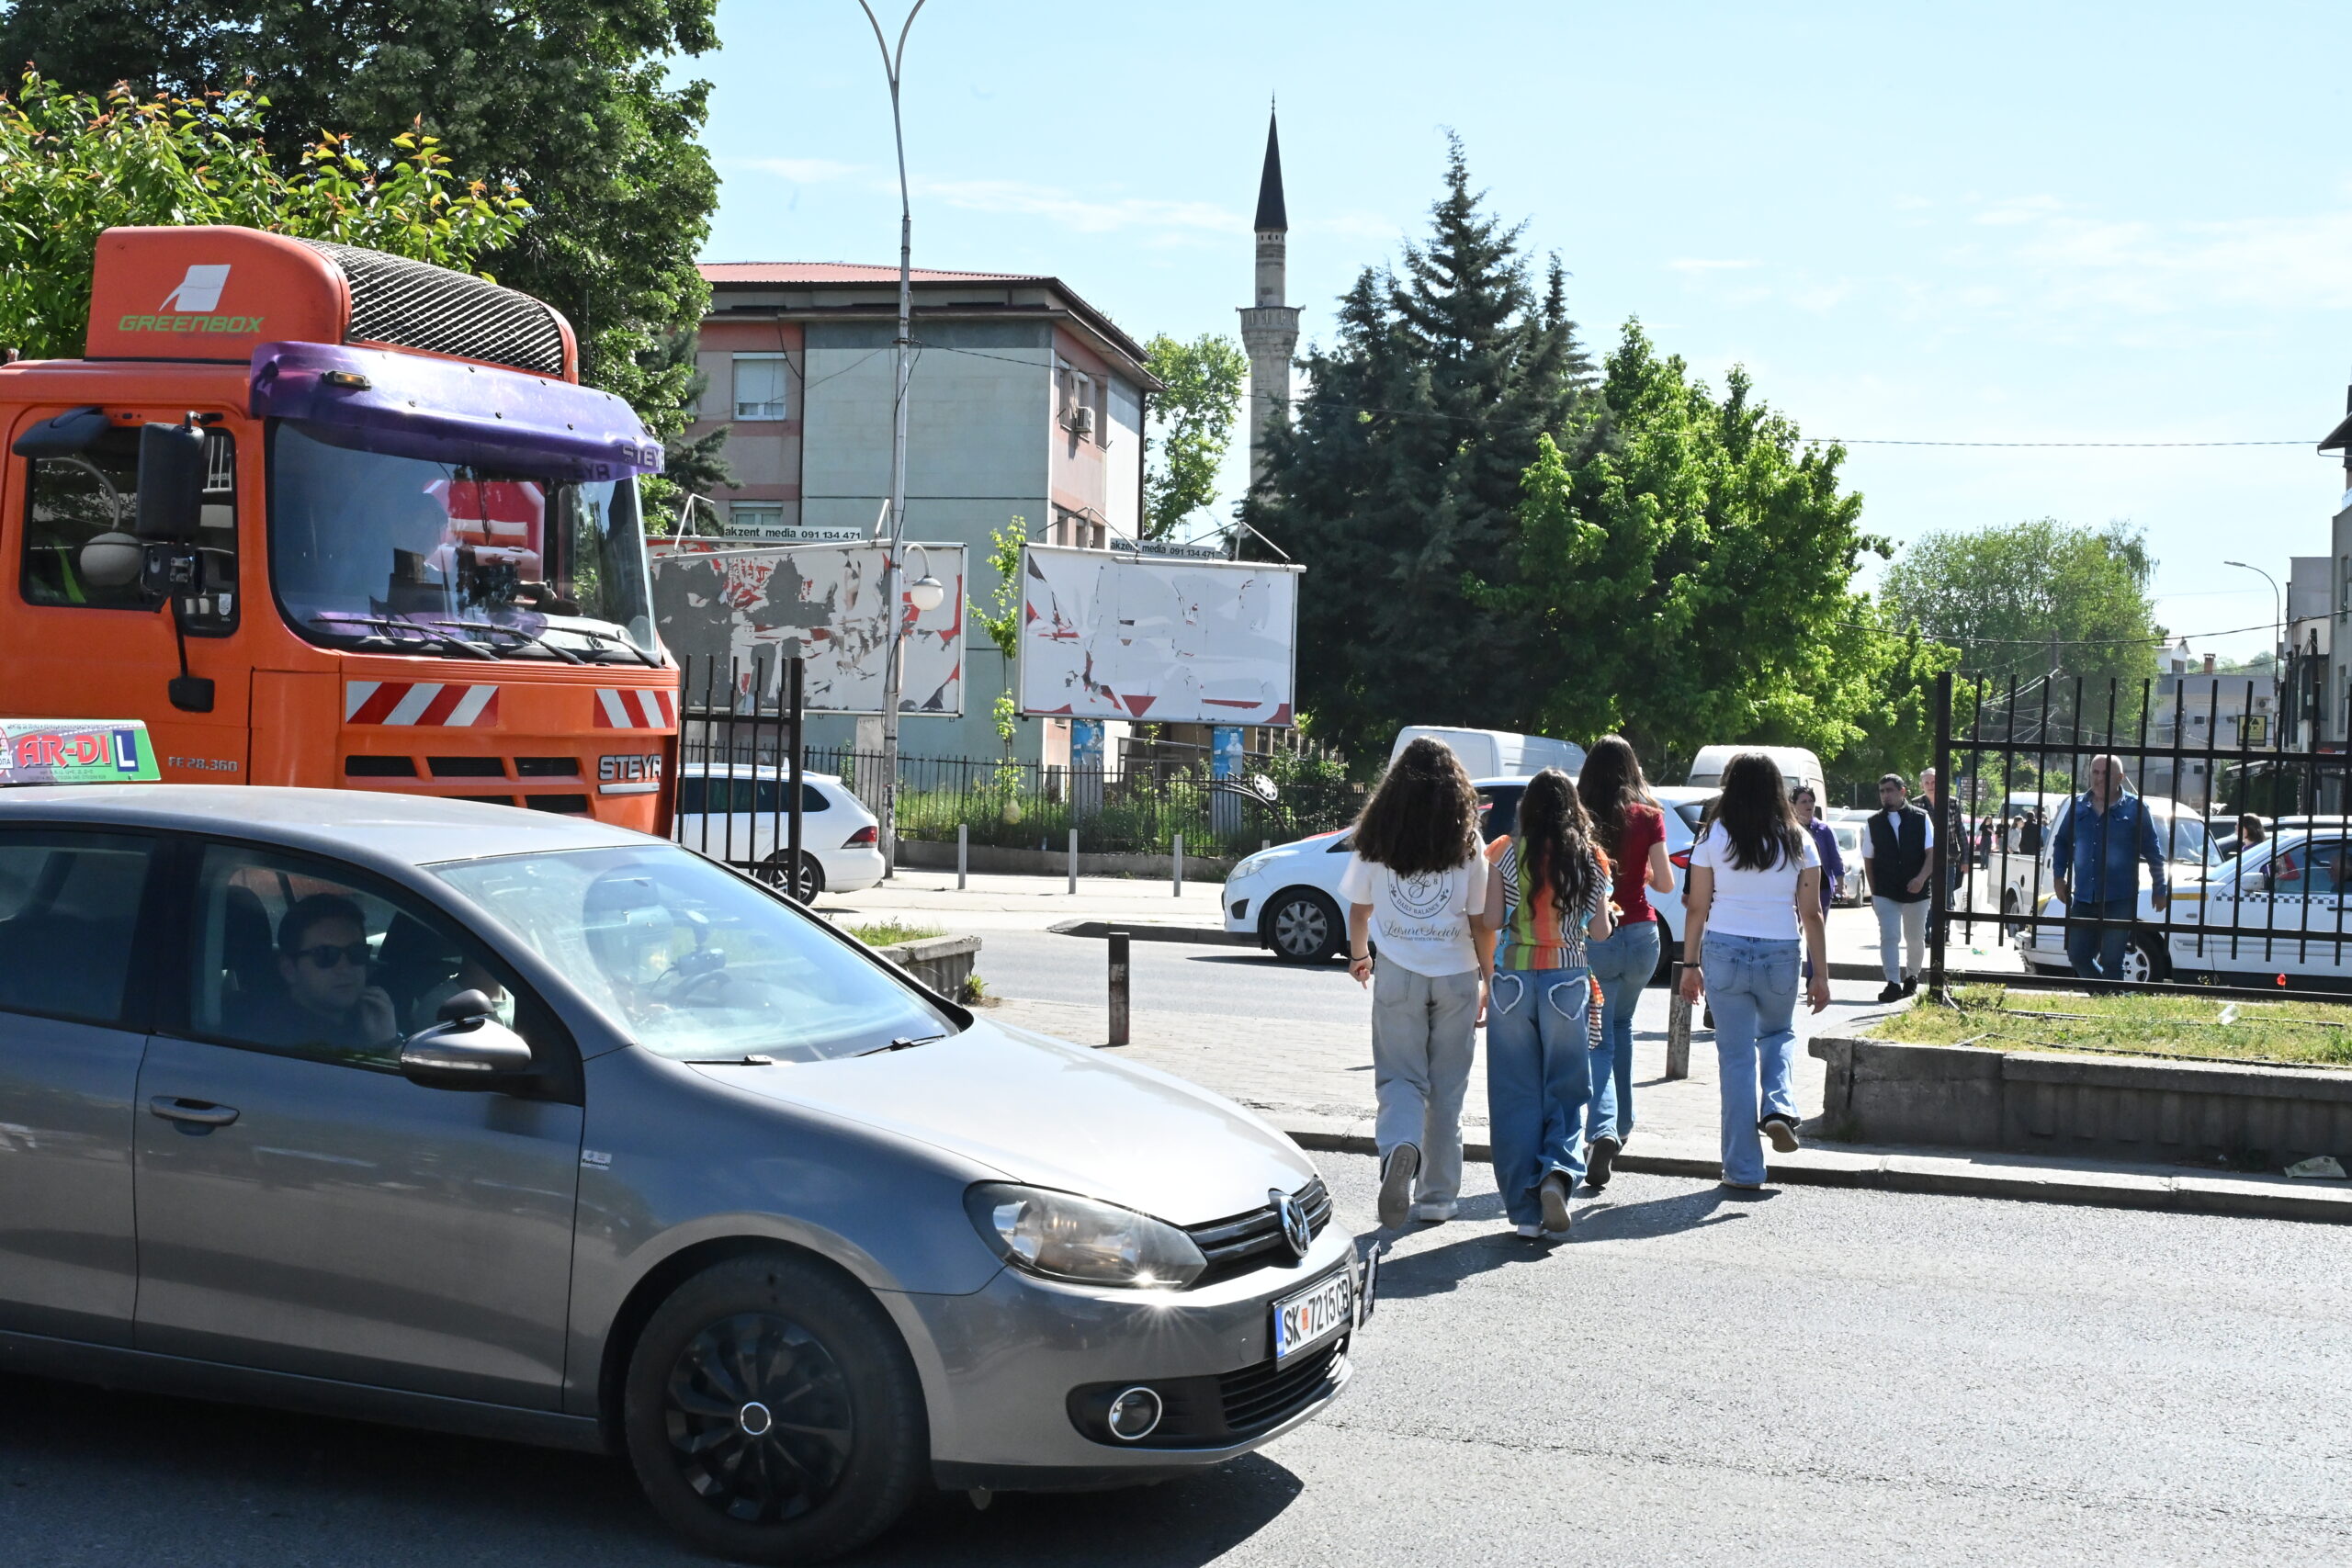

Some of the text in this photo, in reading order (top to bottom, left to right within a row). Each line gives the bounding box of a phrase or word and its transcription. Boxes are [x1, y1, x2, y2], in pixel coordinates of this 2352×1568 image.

[725, 526, 861, 540] akzent media 091 134 471
[1142, 544, 1167, 554] media
[1170, 547, 1184, 556] 091
[1201, 550, 1216, 558] 471
[17, 735, 112, 769] AR-DI
[115, 735, 136, 768] L
[168, 756, 238, 773] FE 28.360
[598, 754, 662, 780] STEYR
[1396, 898, 1441, 915] DAILY BALANCE
[1283, 1303, 1302, 1347] SK
